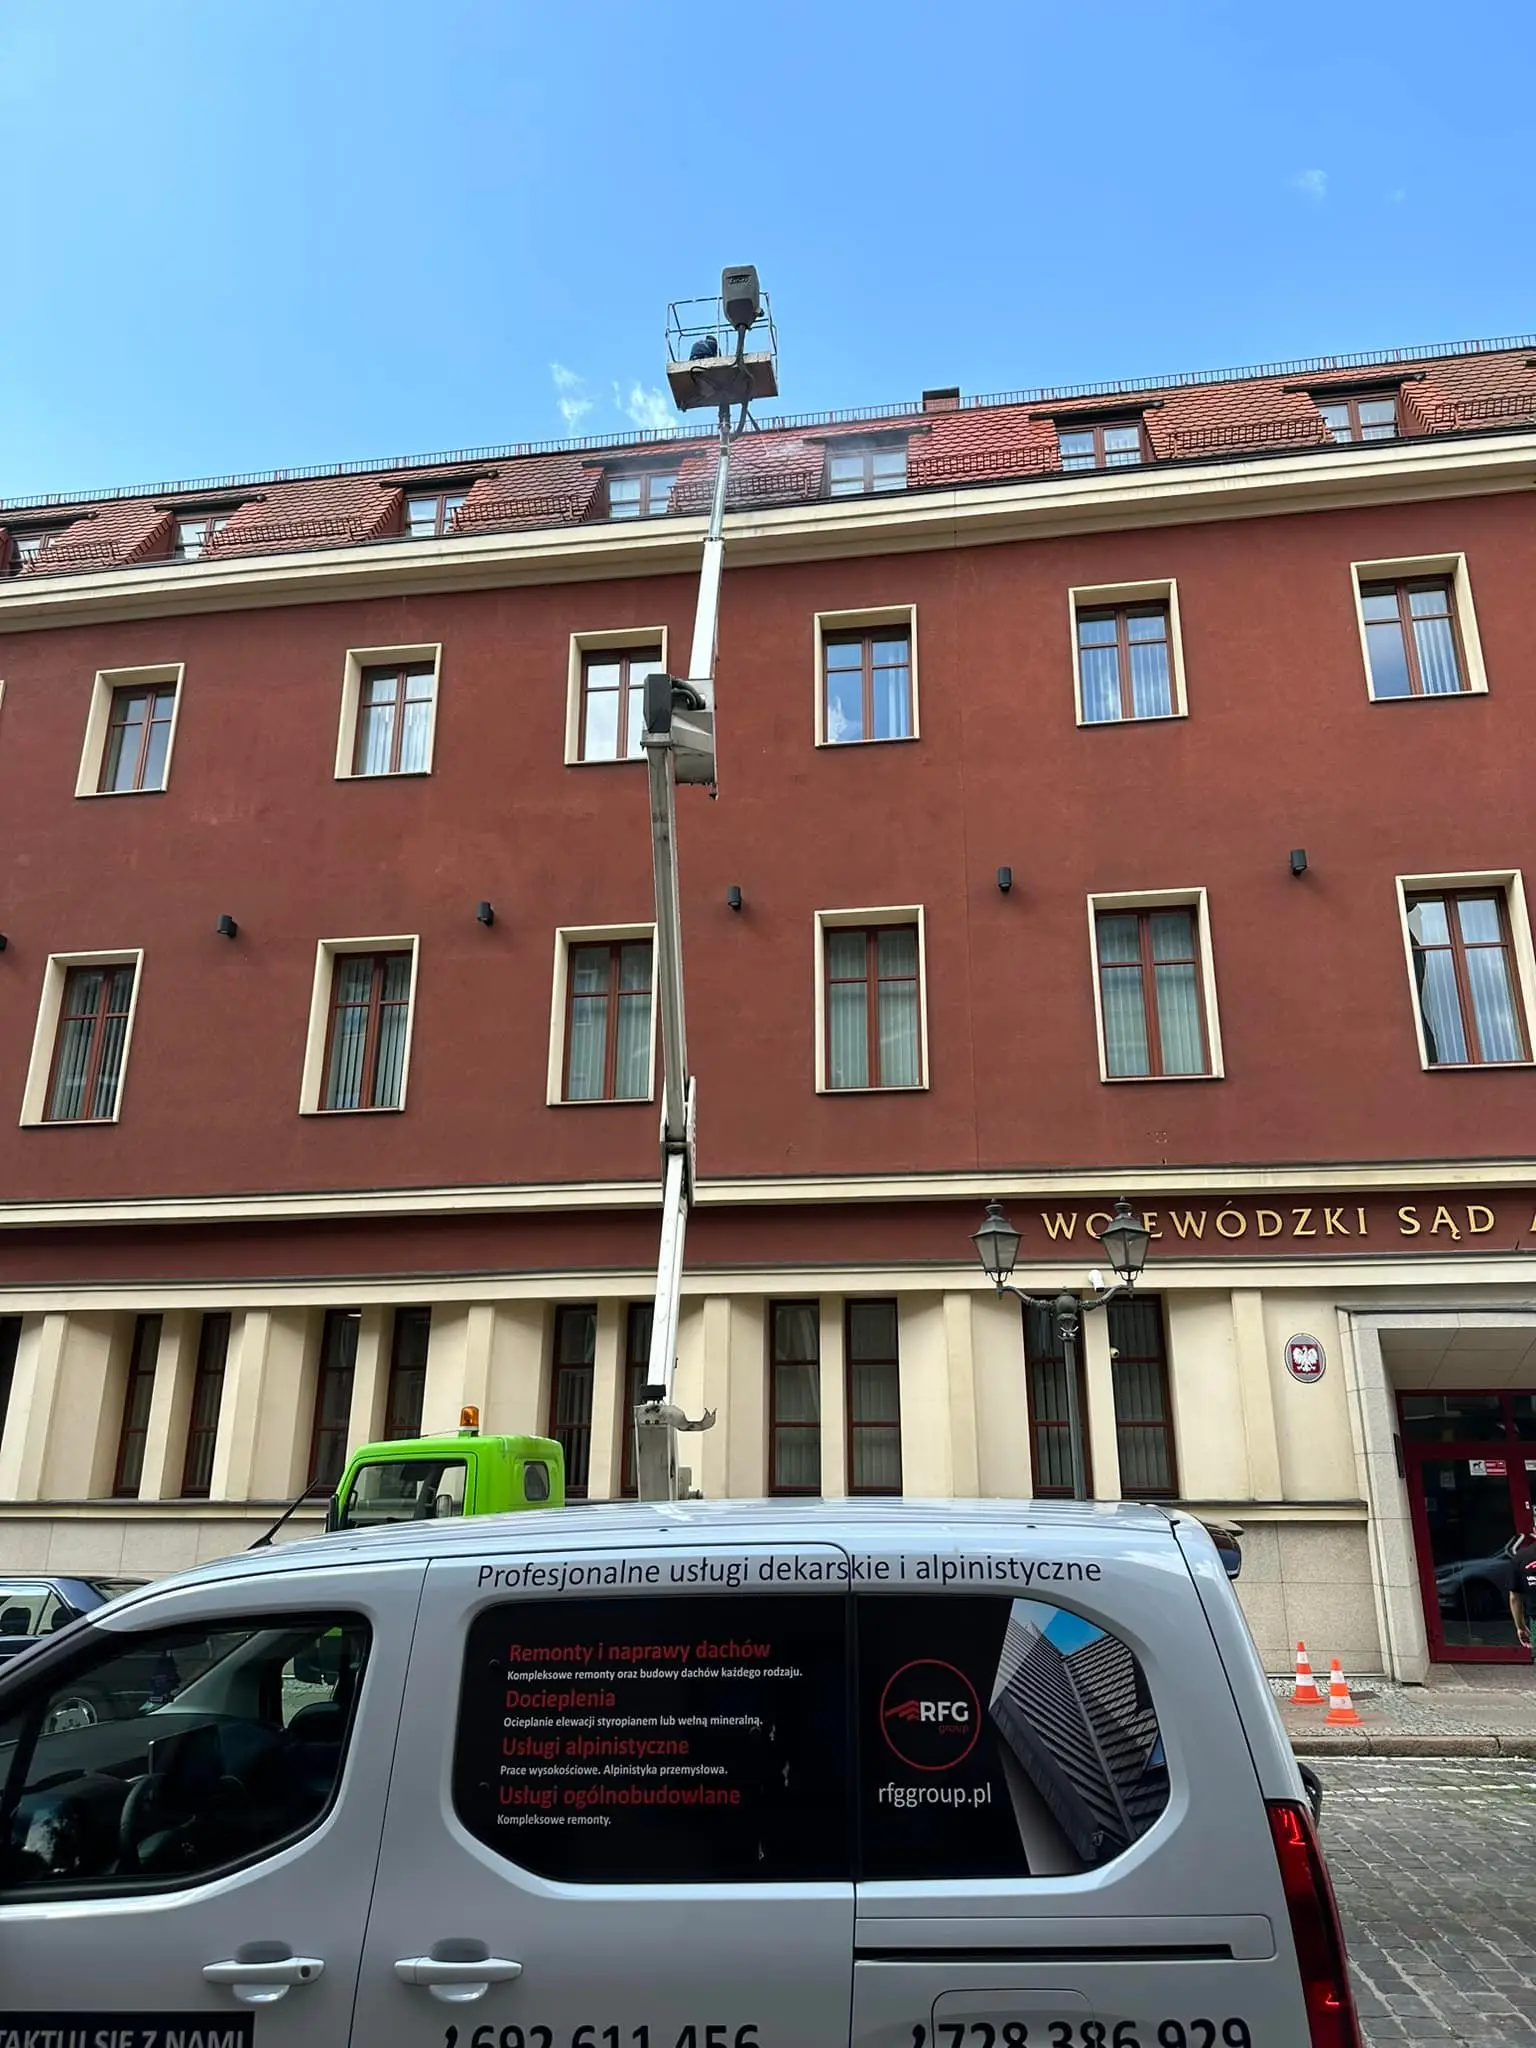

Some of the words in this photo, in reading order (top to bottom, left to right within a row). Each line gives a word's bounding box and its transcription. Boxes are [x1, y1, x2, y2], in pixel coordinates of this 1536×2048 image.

[1040, 1200, 1369, 1242] WOEWÓDZKI
[1398, 1204, 1496, 1240] SĄD
[477, 1559, 661, 1592] Profesjonalne
[670, 1556, 749, 1588] usługi
[758, 1554, 889, 1581] dekarskie
[900, 1555, 905, 1580] i
[916, 1554, 1102, 1586] alpinistyczne
[509, 1644, 592, 1665] Remonty
[598, 1642, 604, 1660] i
[608, 1646, 690, 1664] naprawy
[695, 1638, 772, 1659] dachów
[507, 1670, 573, 1682] Kompleksowe
[574, 1669, 616, 1681] remonty
[616, 1670, 638, 1679] oraz
[639, 1668, 679, 1680] budowy
[680, 1667, 719, 1679] dachów
[721, 1666, 761, 1679] każdego
[763, 1665, 803, 1678] rodzaju.
[505, 1687, 616, 1712] Docieplenia
[919, 1701, 970, 1722] RFG
[503, 1716, 554, 1729] Ocieplanie
[555, 1715, 596, 1728] elewacji
[597, 1714, 658, 1728] styropianem
[659, 1714, 676, 1726] lub
[678, 1714, 708, 1728] wełną
[710, 1713, 764, 1728] mineralną.
[938, 1725, 970, 1735] group
[502, 1735, 561, 1760] Usługi
[565, 1734, 690, 1759] alpinistyczne
[500, 1765, 527, 1776] Prace
[528, 1763, 601, 1777] wysokościowe.
[602, 1763, 658, 1777] Alpinistyka
[659, 1763, 729, 1777] przemysłowa.
[500, 1783, 559, 1809] Usługi
[562, 1783, 742, 1810] ogólnobudowlane
[878, 1781, 992, 1808] rfggroup.pl
[497, 1813, 566, 1827] Kompleksowe
[566, 1813, 612, 1827] remonty.
